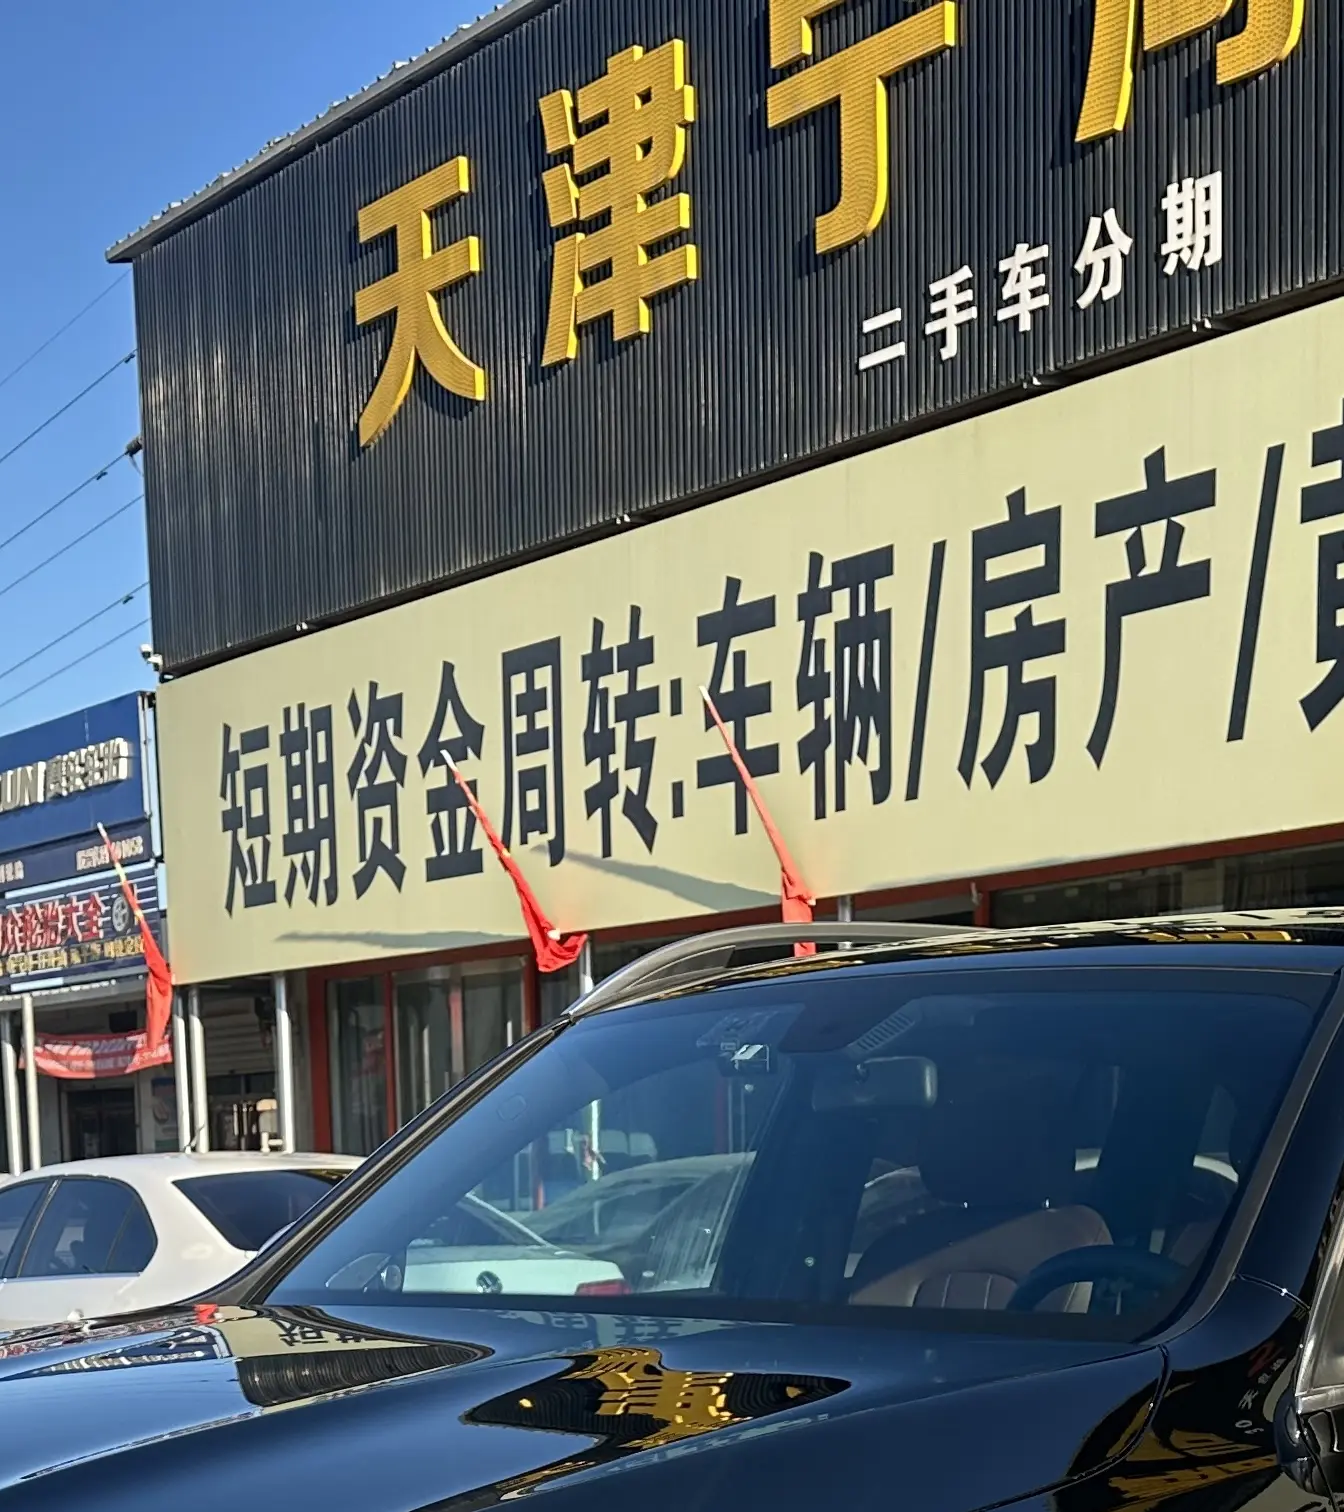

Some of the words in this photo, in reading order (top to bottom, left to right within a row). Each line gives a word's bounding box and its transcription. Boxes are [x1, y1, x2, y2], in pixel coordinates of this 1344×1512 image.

[858, 170, 1222, 371] 二手车分期
